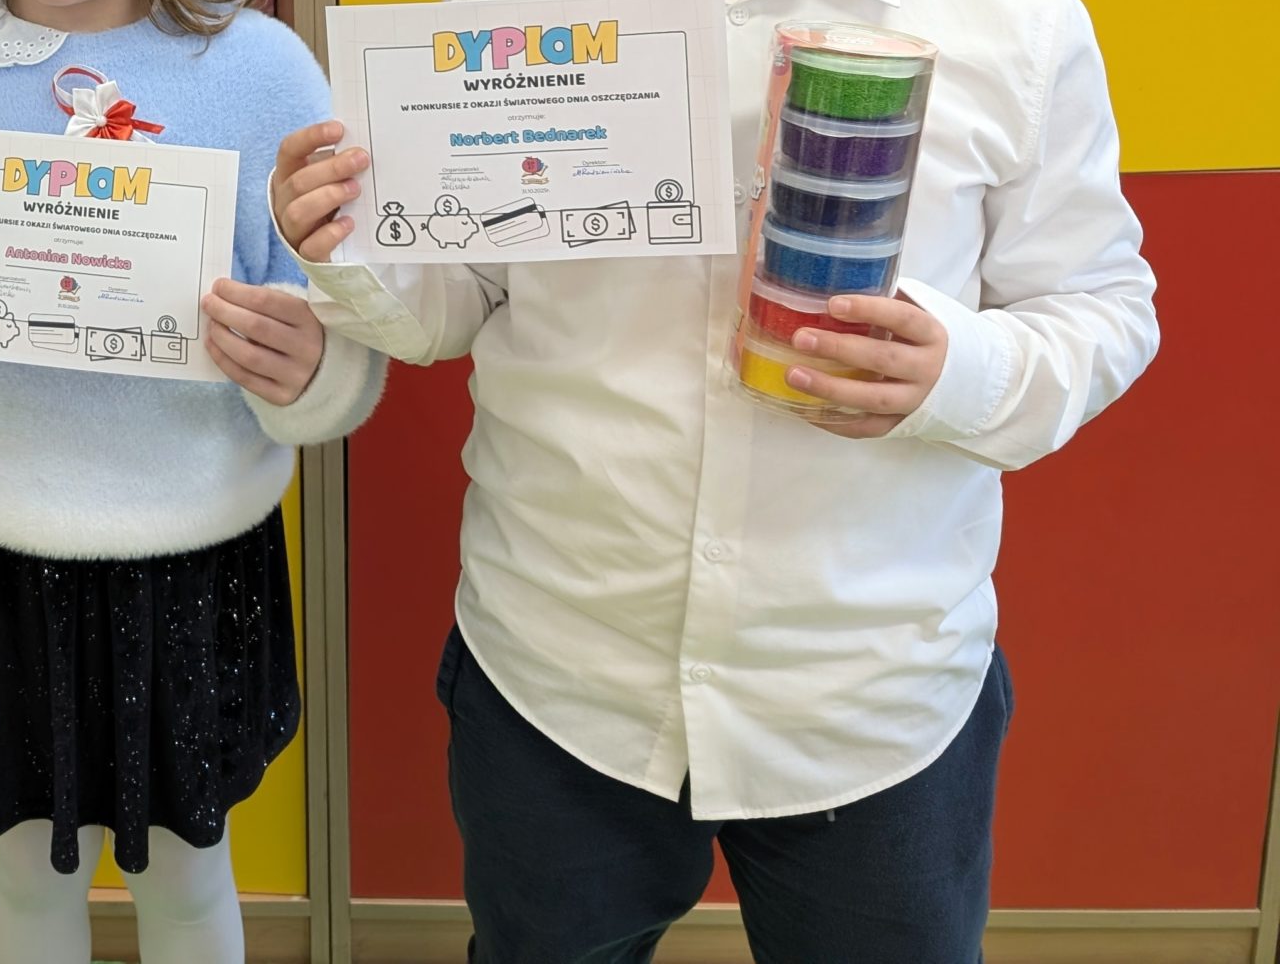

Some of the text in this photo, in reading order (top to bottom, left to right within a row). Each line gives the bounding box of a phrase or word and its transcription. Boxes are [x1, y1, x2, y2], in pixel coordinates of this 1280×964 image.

[432, 19, 619, 73] DYPLOM
[463, 72, 586, 92] WYRÓŻNIENIE
[401, 91, 661, 112] W KONKURSIE Z OKAZJI ŚWIATOWEGO DNIA OSZCZĘDZANIA
[449, 124, 608, 147] Norbert Bednarek
[1, 156, 153, 205] DYPLOM
[23, 200, 121, 221] WYRÓŻNIENIE
[20, 219, 26, 227] Z
[26, 220, 52, 230] OKAZJI
[52, 222, 102, 235] ŚWIATOWEGO
[102, 227, 121, 236] DNIA
[121, 229, 178, 242] OSZCZĘDZANIA
[4, 245, 133, 271] Antonina Nowicka
